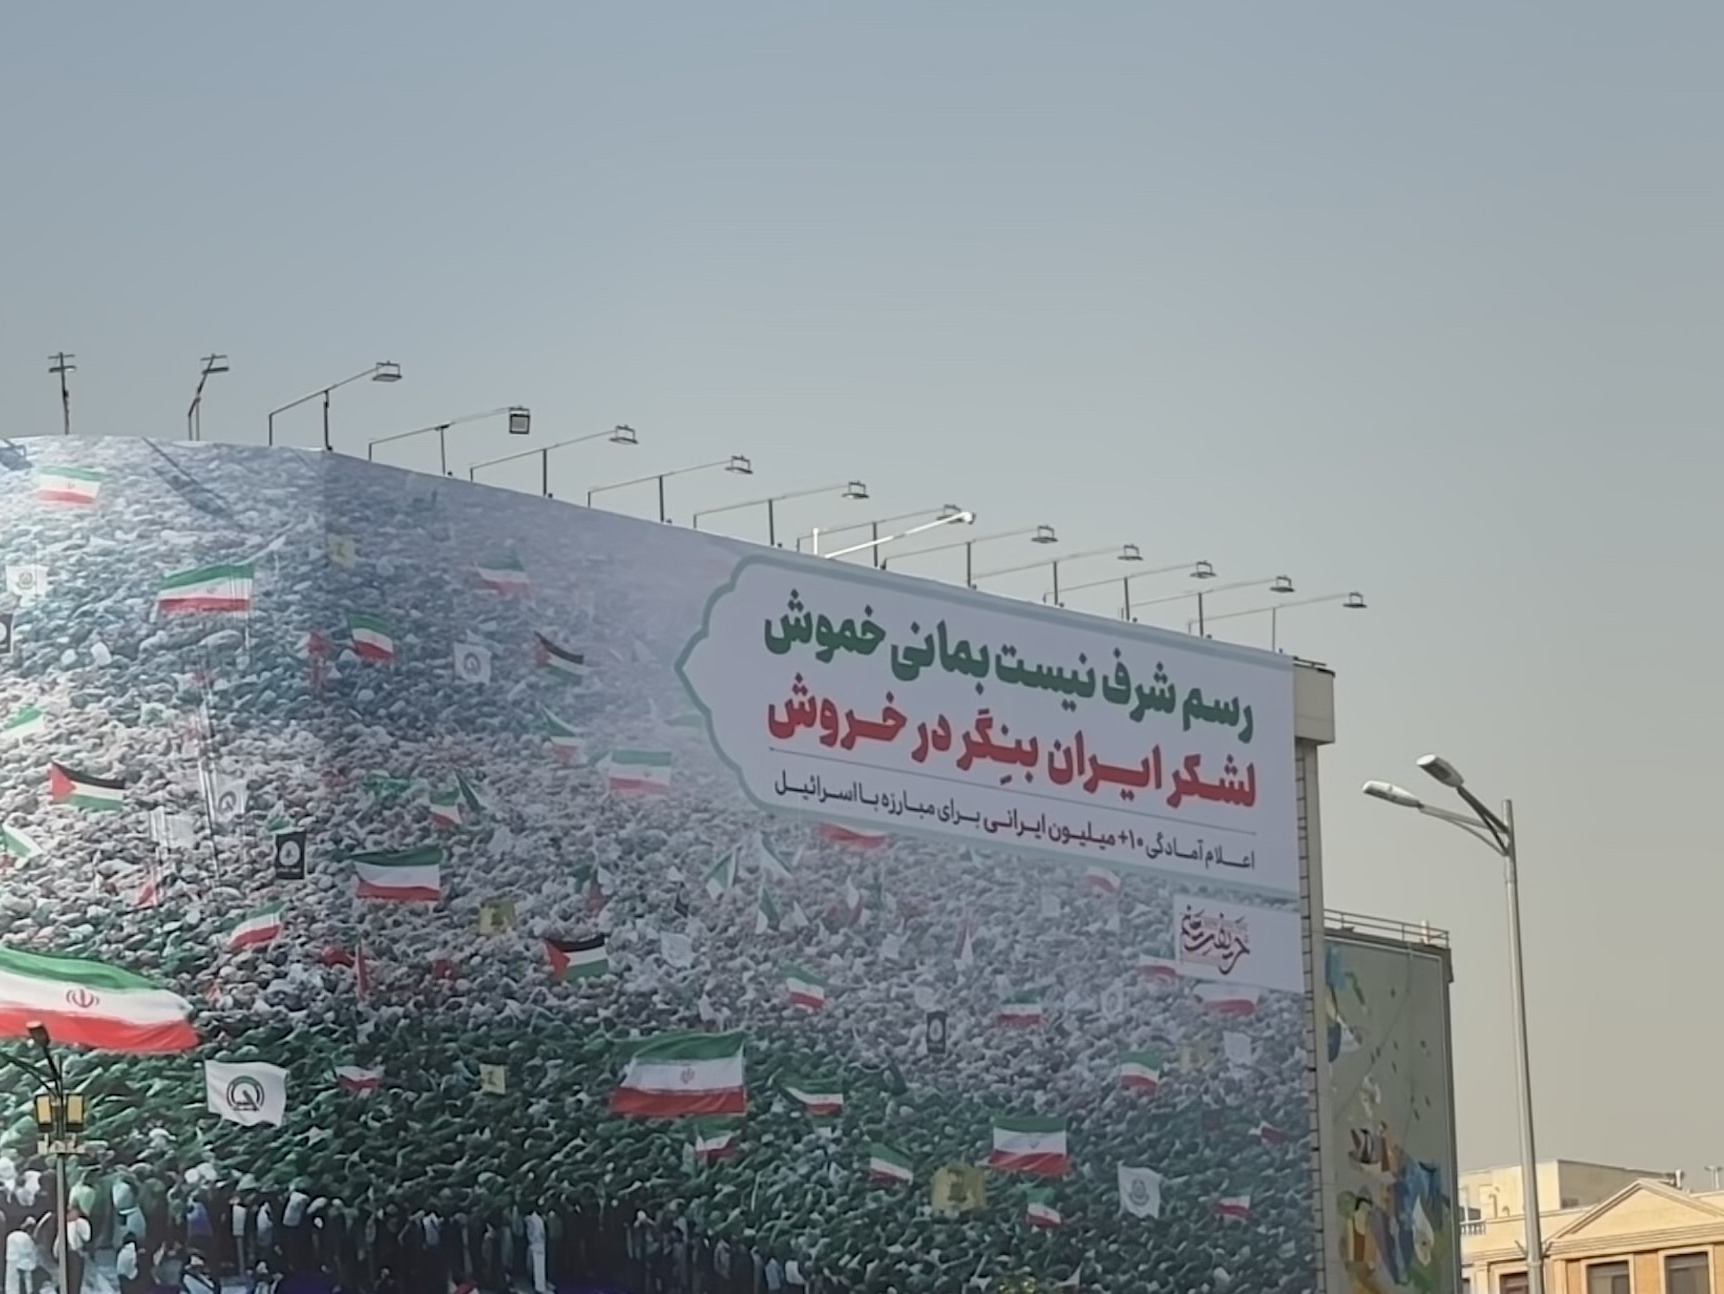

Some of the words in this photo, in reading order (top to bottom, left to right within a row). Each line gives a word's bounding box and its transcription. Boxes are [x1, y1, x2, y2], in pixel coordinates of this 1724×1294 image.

[764, 588, 886, 664] خموش
[891, 619, 990, 695] بمانی
[994, 643, 1096, 712] نیست
[1102, 647, 1177, 723] شرف
[768, 672, 908, 750] خروش
[1182, 687, 1254, 744] رسم
[911, 713, 952, 763] در
[775, 769, 857, 803] اسرائیل
[1047, 730, 1162, 801] ایران
[1166, 753, 1256, 808] لشکر
[858, 782, 880, 811] با
[880, 789, 936, 820] مبارزه
[937, 797, 981, 827] برای
[983, 808, 1046, 839] ایرانی
[1048, 820, 1116, 850] میلیون
[1146, 831, 1204, 861] آمادگی
[1205, 845, 1255, 870] اعلام
